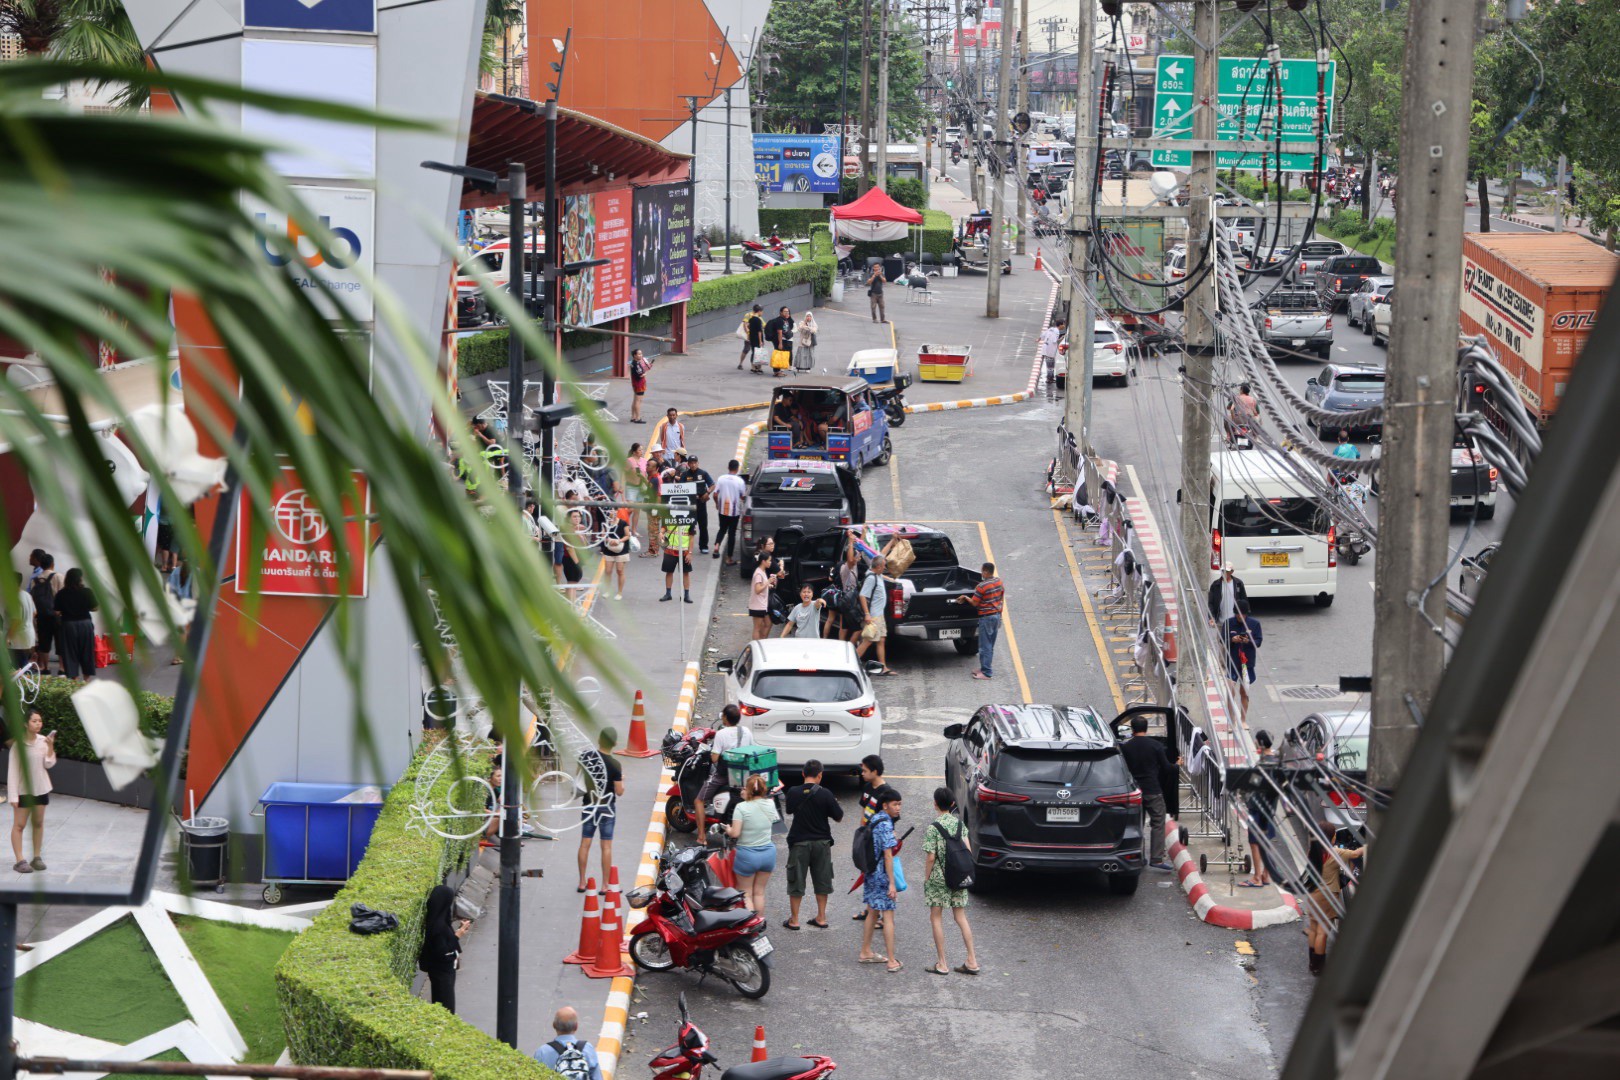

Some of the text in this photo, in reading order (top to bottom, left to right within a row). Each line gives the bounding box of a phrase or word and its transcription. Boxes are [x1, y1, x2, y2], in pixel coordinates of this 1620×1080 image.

[1162, 80, 1177, 89] 650
[1157, 153, 1170, 163] 4.8
[678, 517, 696, 525] STOP
